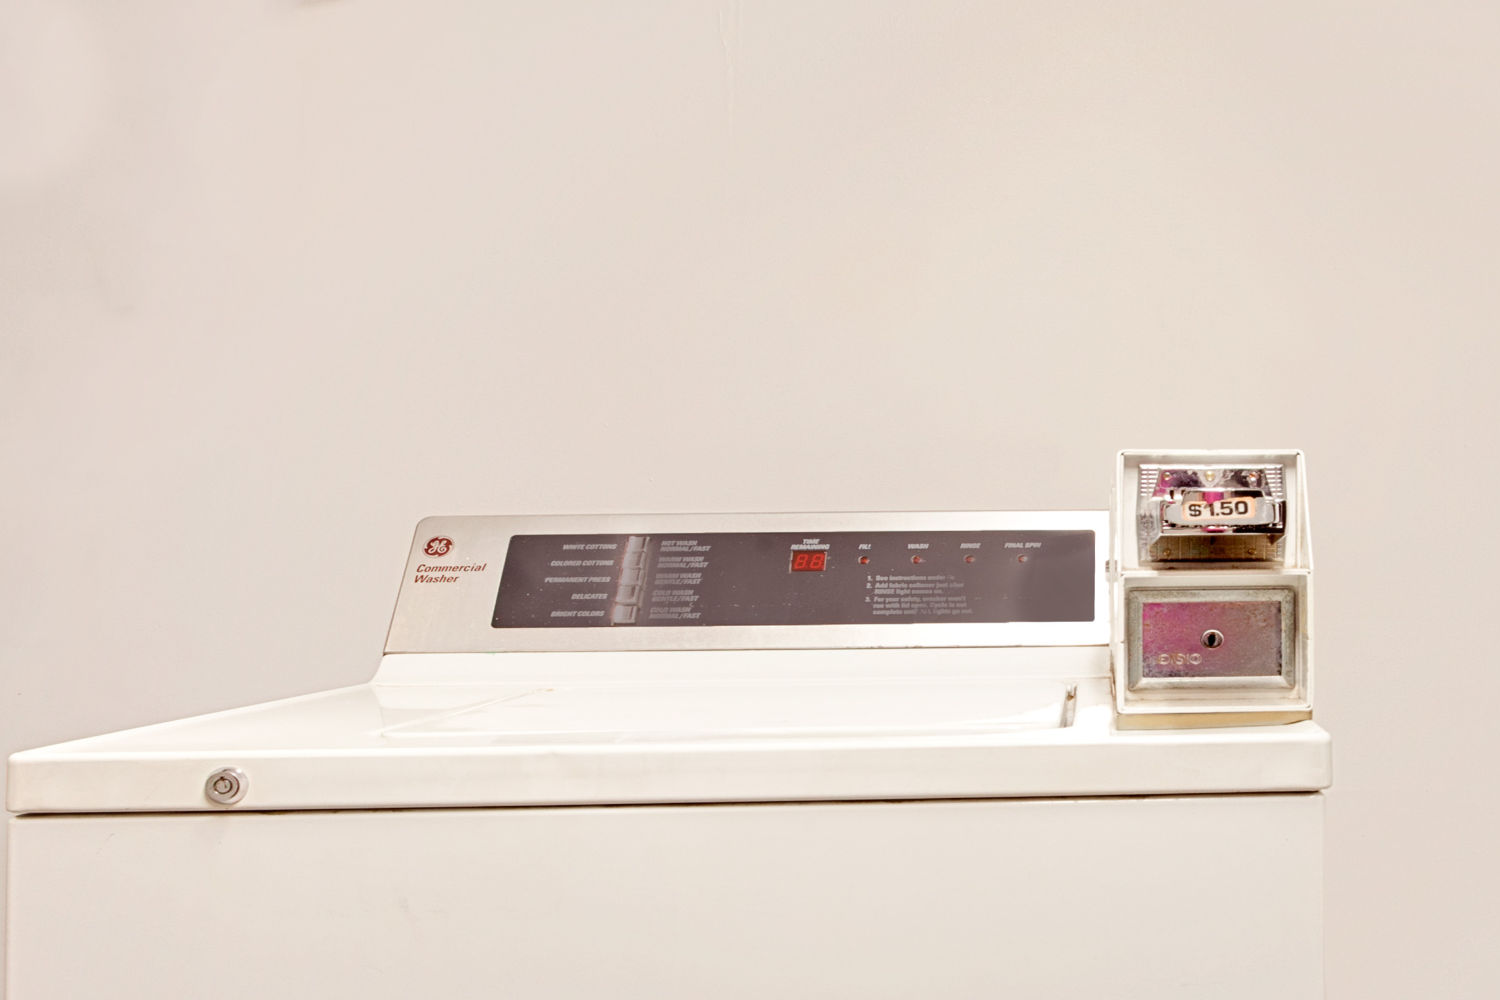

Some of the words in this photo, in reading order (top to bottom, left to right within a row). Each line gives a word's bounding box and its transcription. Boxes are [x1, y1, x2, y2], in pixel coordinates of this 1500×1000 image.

[1189, 501, 1248, 517] $1.50
[417, 563, 487, 572] Commercial
[414, 575, 459, 583] Washer
